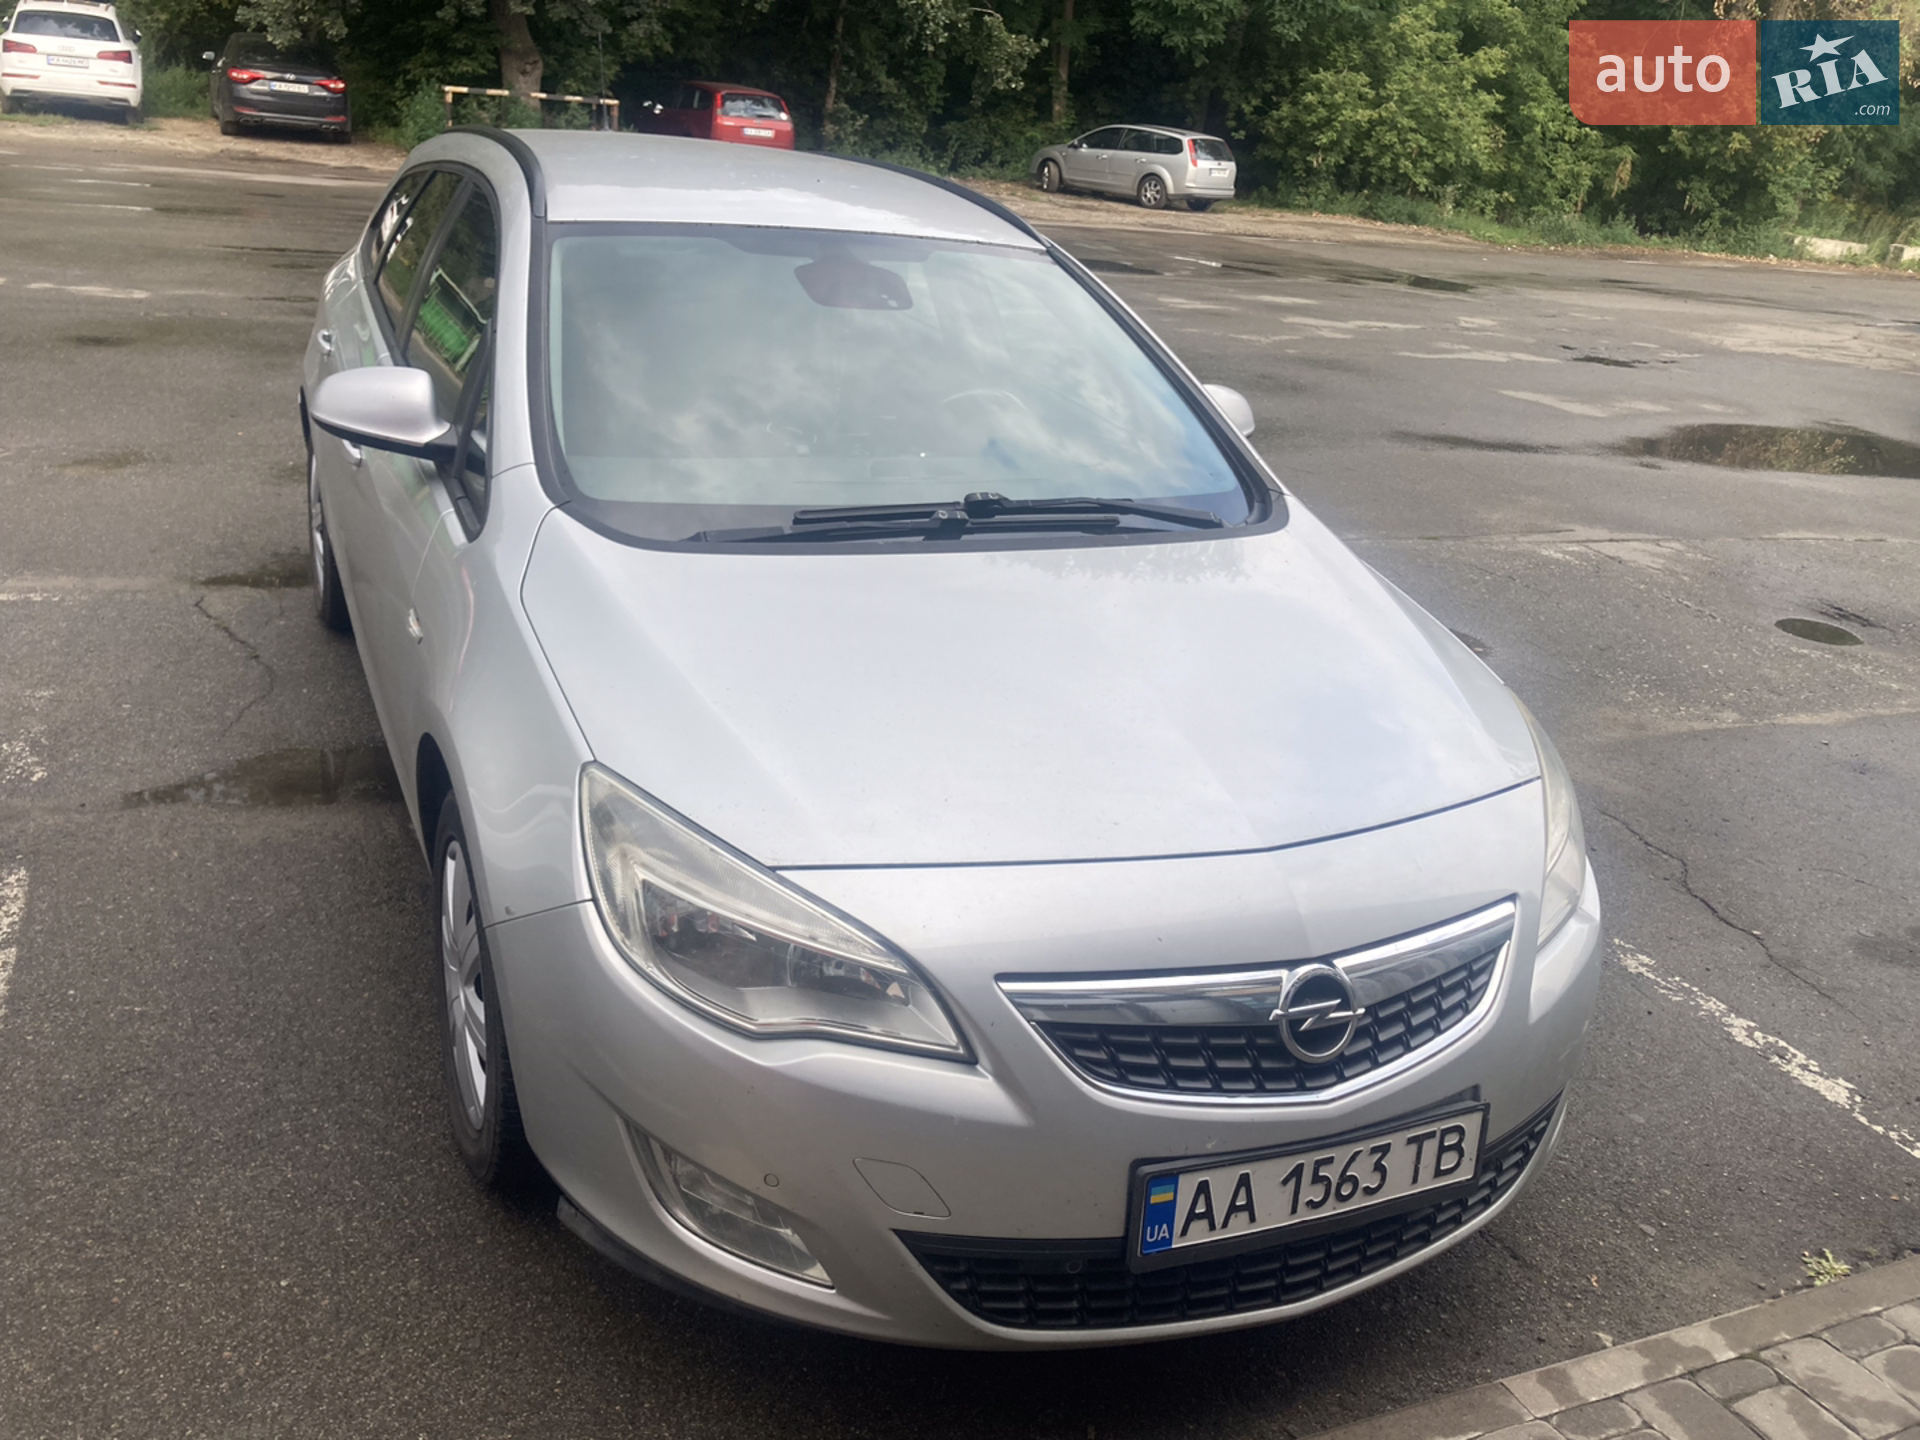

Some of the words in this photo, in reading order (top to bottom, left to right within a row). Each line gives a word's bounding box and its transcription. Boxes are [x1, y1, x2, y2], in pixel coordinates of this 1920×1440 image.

[1179, 1171, 1257, 1237] AA
[1280, 1141, 1393, 1216] 1563
[1405, 1123, 1467, 1185] TB
[1146, 1224, 1170, 1243] UA
